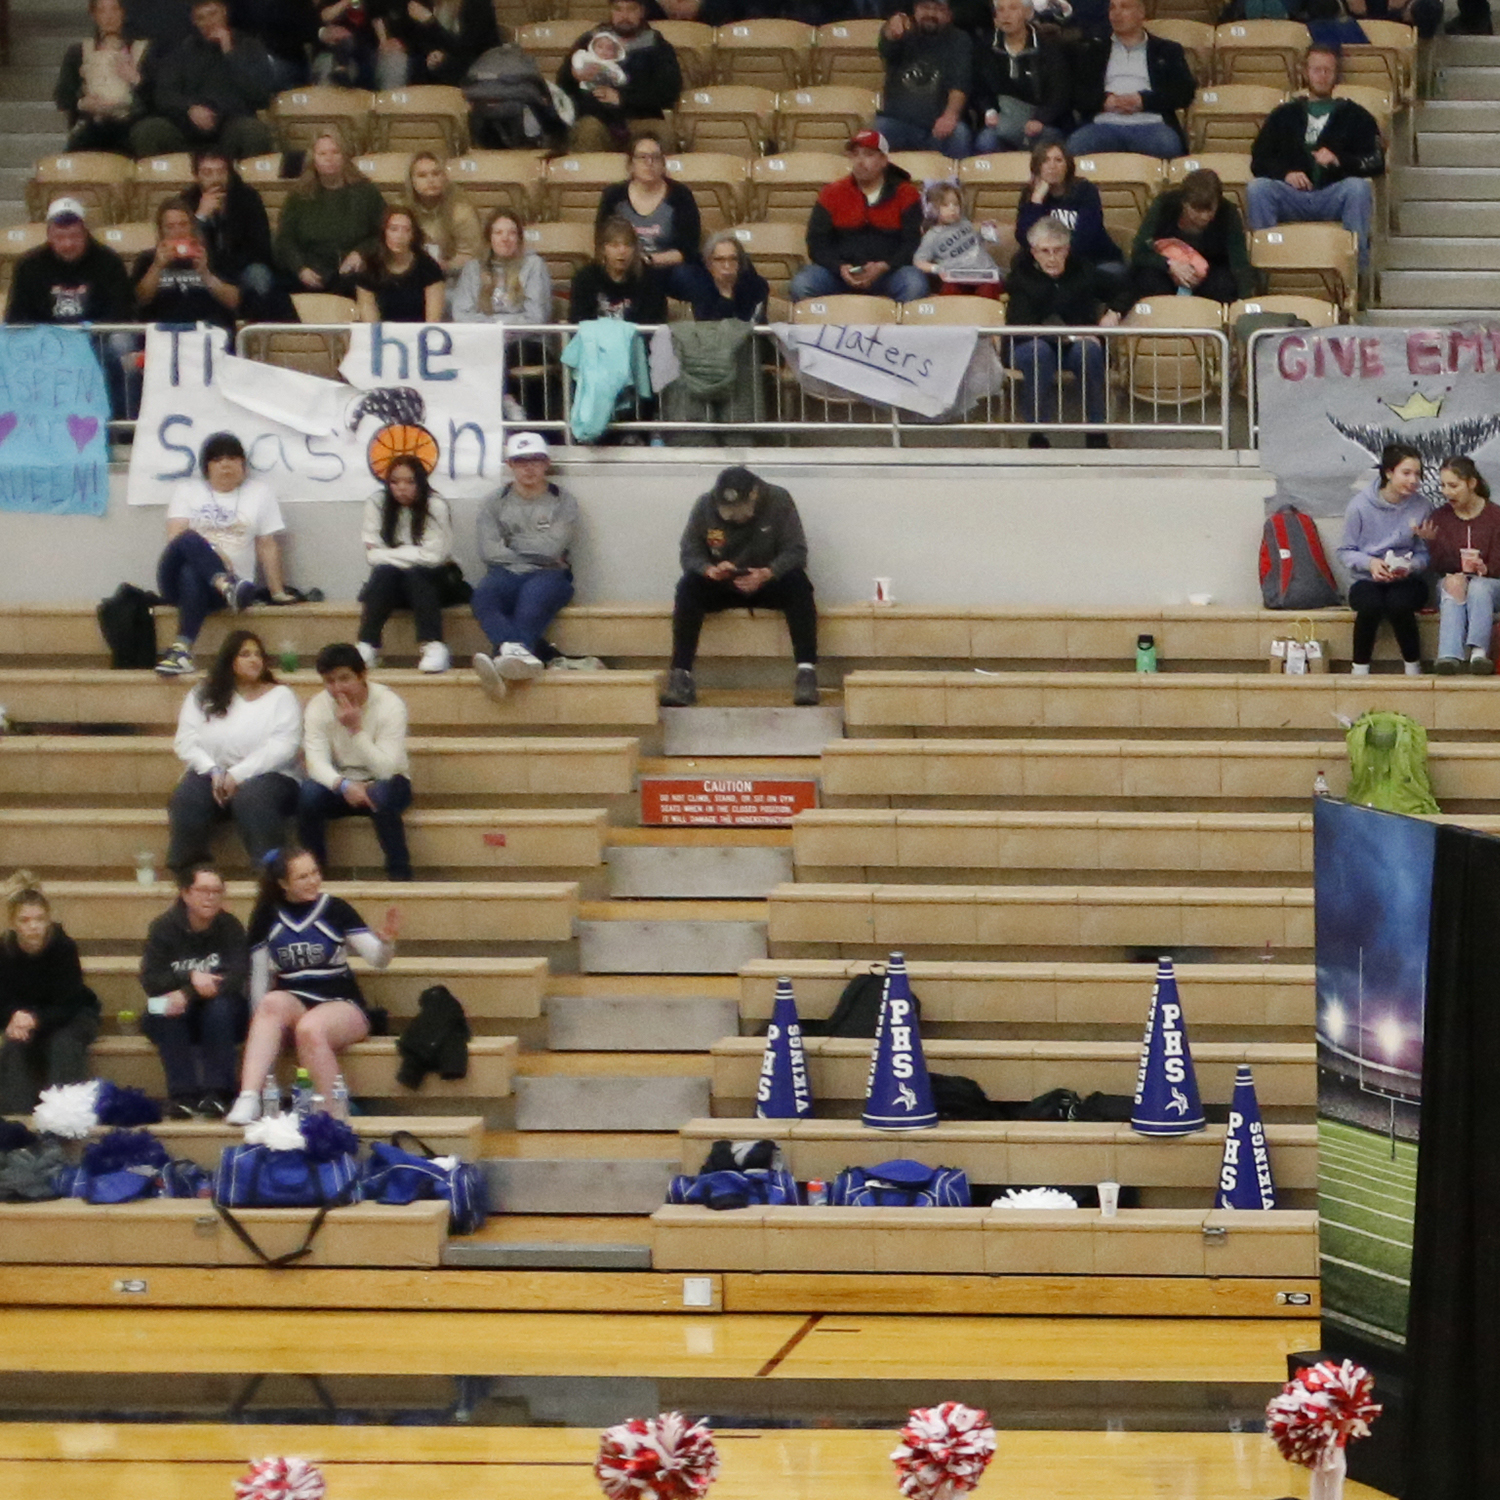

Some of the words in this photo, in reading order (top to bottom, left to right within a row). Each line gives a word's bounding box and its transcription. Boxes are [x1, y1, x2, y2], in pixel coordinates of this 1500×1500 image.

[370, 321, 459, 381] he
[815, 323, 934, 378] Haters
[1277, 335, 1385, 382] GIVE
[153, 413, 487, 482] Sasn
[704, 780, 753, 792] CAUTION
[277, 942, 324, 967] PHS
[757, 1024, 780, 1101] PHS
[788, 1024, 809, 1113] VIKINGS
[889, 999, 914, 1079] PHS
[1161, 1004, 1186, 1083] PHS
[1220, 1111, 1244, 1192] PHS
[1249, 1121, 1275, 1211] VIKINGS
